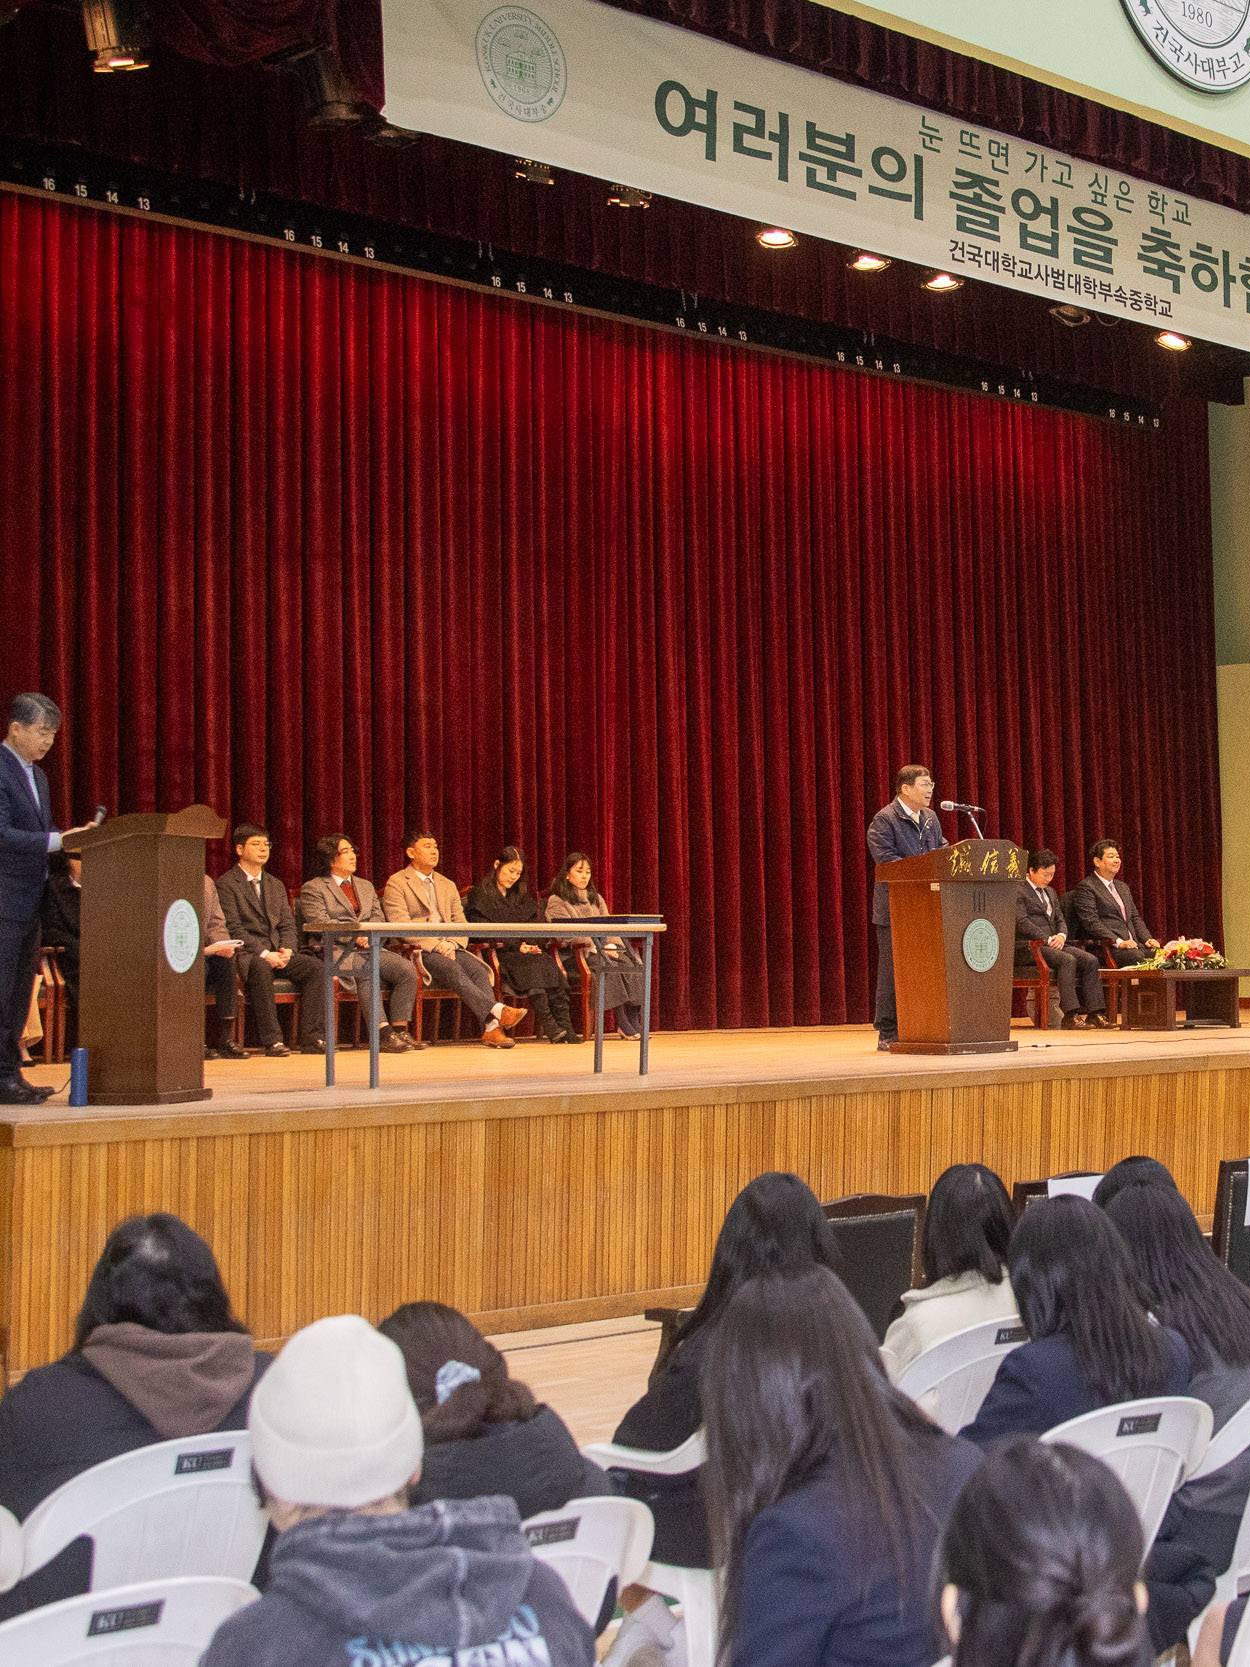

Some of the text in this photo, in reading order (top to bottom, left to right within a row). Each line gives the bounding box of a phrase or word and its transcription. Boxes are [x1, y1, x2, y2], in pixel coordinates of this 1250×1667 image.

[1181, 1, 1213, 28] 1980
[1152, 19, 1245, 81] 건국사대부고
[654, 79, 924, 221] 여러분의
[949, 167, 1119, 276] 졸업을
[918, 115, 1192, 227] 눈 뜨면 가고 싶은 학교
[43, 177, 150, 211] 16 15 14 13
[283, 229, 375, 259] 16 15 14 13
[491, 276, 573, 303] 16 15 14 13
[948, 238, 1173, 319] 건국대학교사범대학부속중학교
[675, 317, 747, 341] 16 15 14 13
[837, 351, 901, 374] 16 15 14 13
[981, 381, 1038, 402] 16 15 14 13
[1109, 408, 1160, 428] 16 15 14 13
